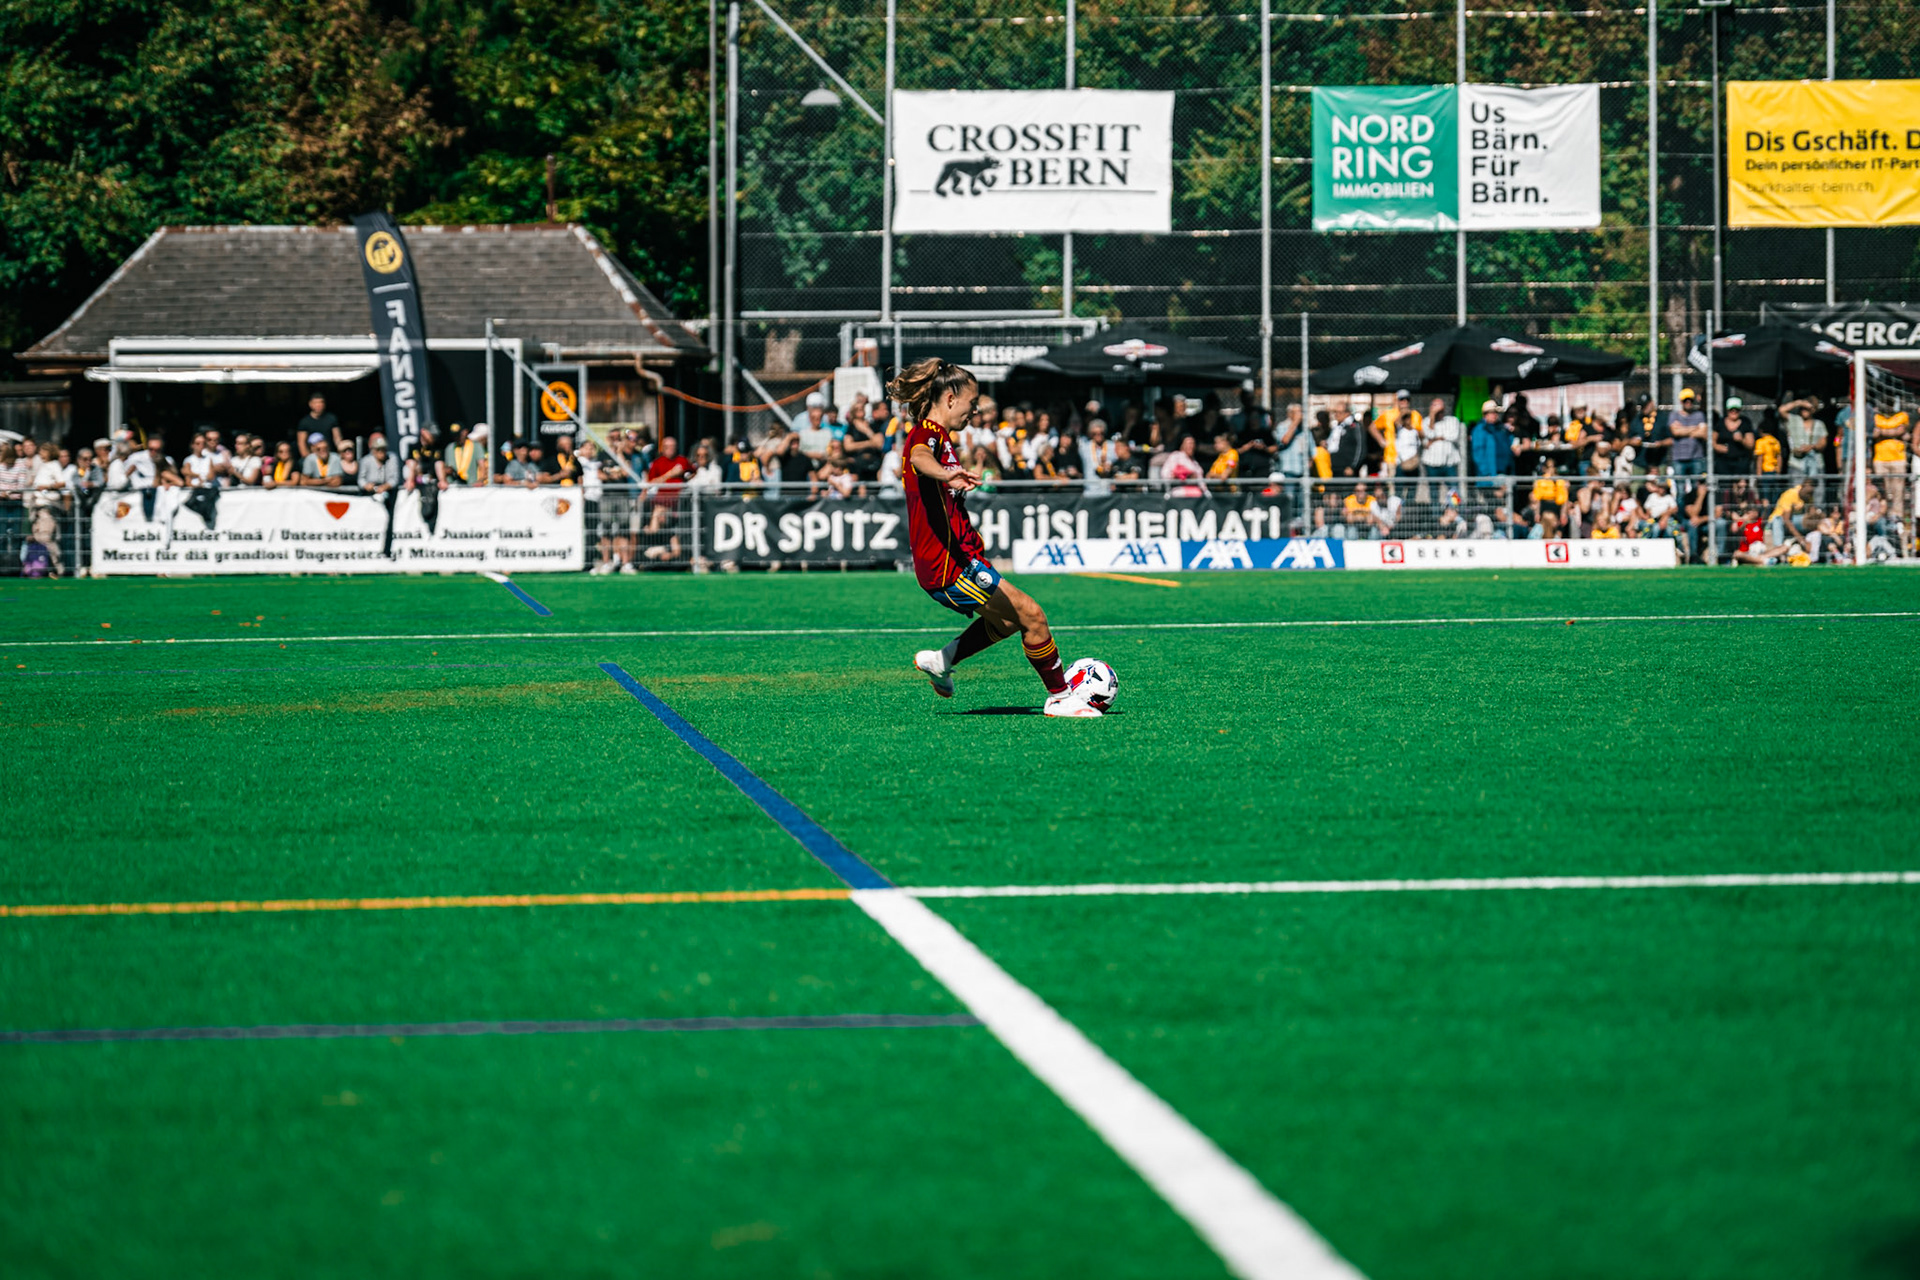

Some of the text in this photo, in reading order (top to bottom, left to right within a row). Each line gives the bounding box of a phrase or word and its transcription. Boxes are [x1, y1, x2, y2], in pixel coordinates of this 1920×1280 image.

[1471, 102, 1506, 124] Us
[927, 123, 1142, 152] CROSSFIT
[1331, 114, 1435, 144] NORD
[1471, 127, 1548, 151] Bärn.
[1745, 131, 1786, 151] Dis
[1792, 129, 1898, 151] Gschäft.
[1009, 157, 1131, 186] BERN
[1331, 146, 1434, 180] RING
[1471, 155, 1520, 177] Für
[1745, 158, 1778, 171] Dein
[1781, 158, 1867, 173] persönlicher
[1332, 182, 1434, 199] IMMOBILIEN
[1471, 181, 1549, 204] Bärn.
[123, 530, 161, 541] Liebi
[714, 511, 770, 557] DR
[778, 509, 900, 553] SPITZ
[103, 549, 150, 561] Merci
[155, 549, 178, 561] für
[184, 549, 208, 561] diä
[1028, 543, 1085, 567] AXA
[1110, 543, 1167, 566] AXA
[1189, 538, 1254, 569] AXA
[1272, 538, 1336, 569] AXA
